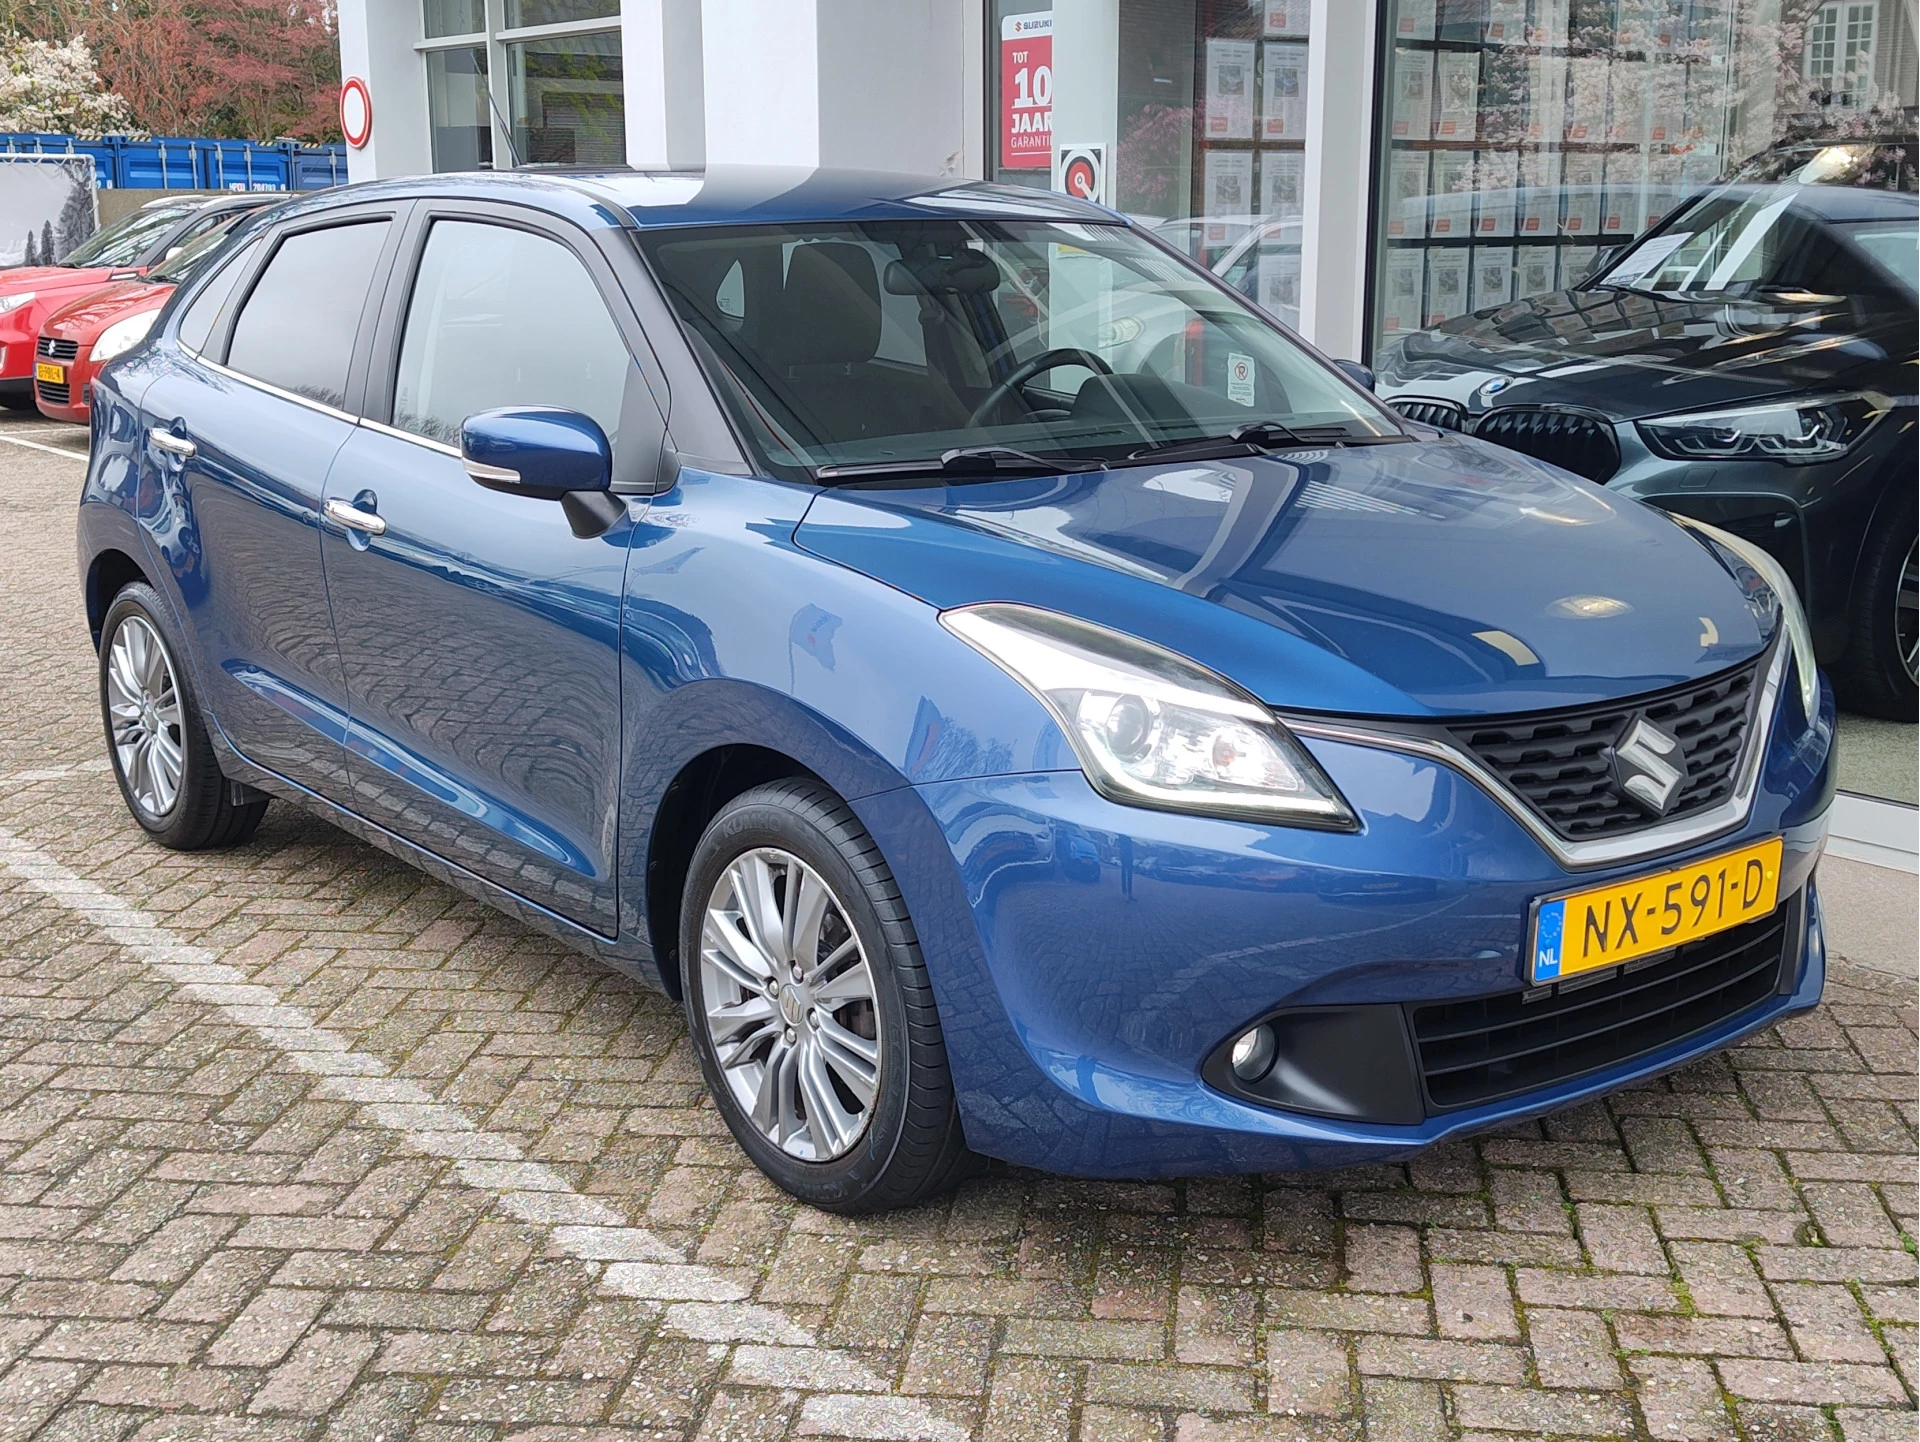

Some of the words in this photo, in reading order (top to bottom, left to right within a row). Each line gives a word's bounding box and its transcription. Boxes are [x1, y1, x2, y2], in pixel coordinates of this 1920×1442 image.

[1023, 19, 1052, 30] SUZUKI
[1012, 51, 1028, 64] TOT
[1014, 65, 1052, 107] 10
[1011, 111, 1052, 133] JAAR
[1011, 135, 1052, 148] GARANTI
[1582, 859, 1764, 958] NX-591-D
[1538, 948, 1558, 968] NL
